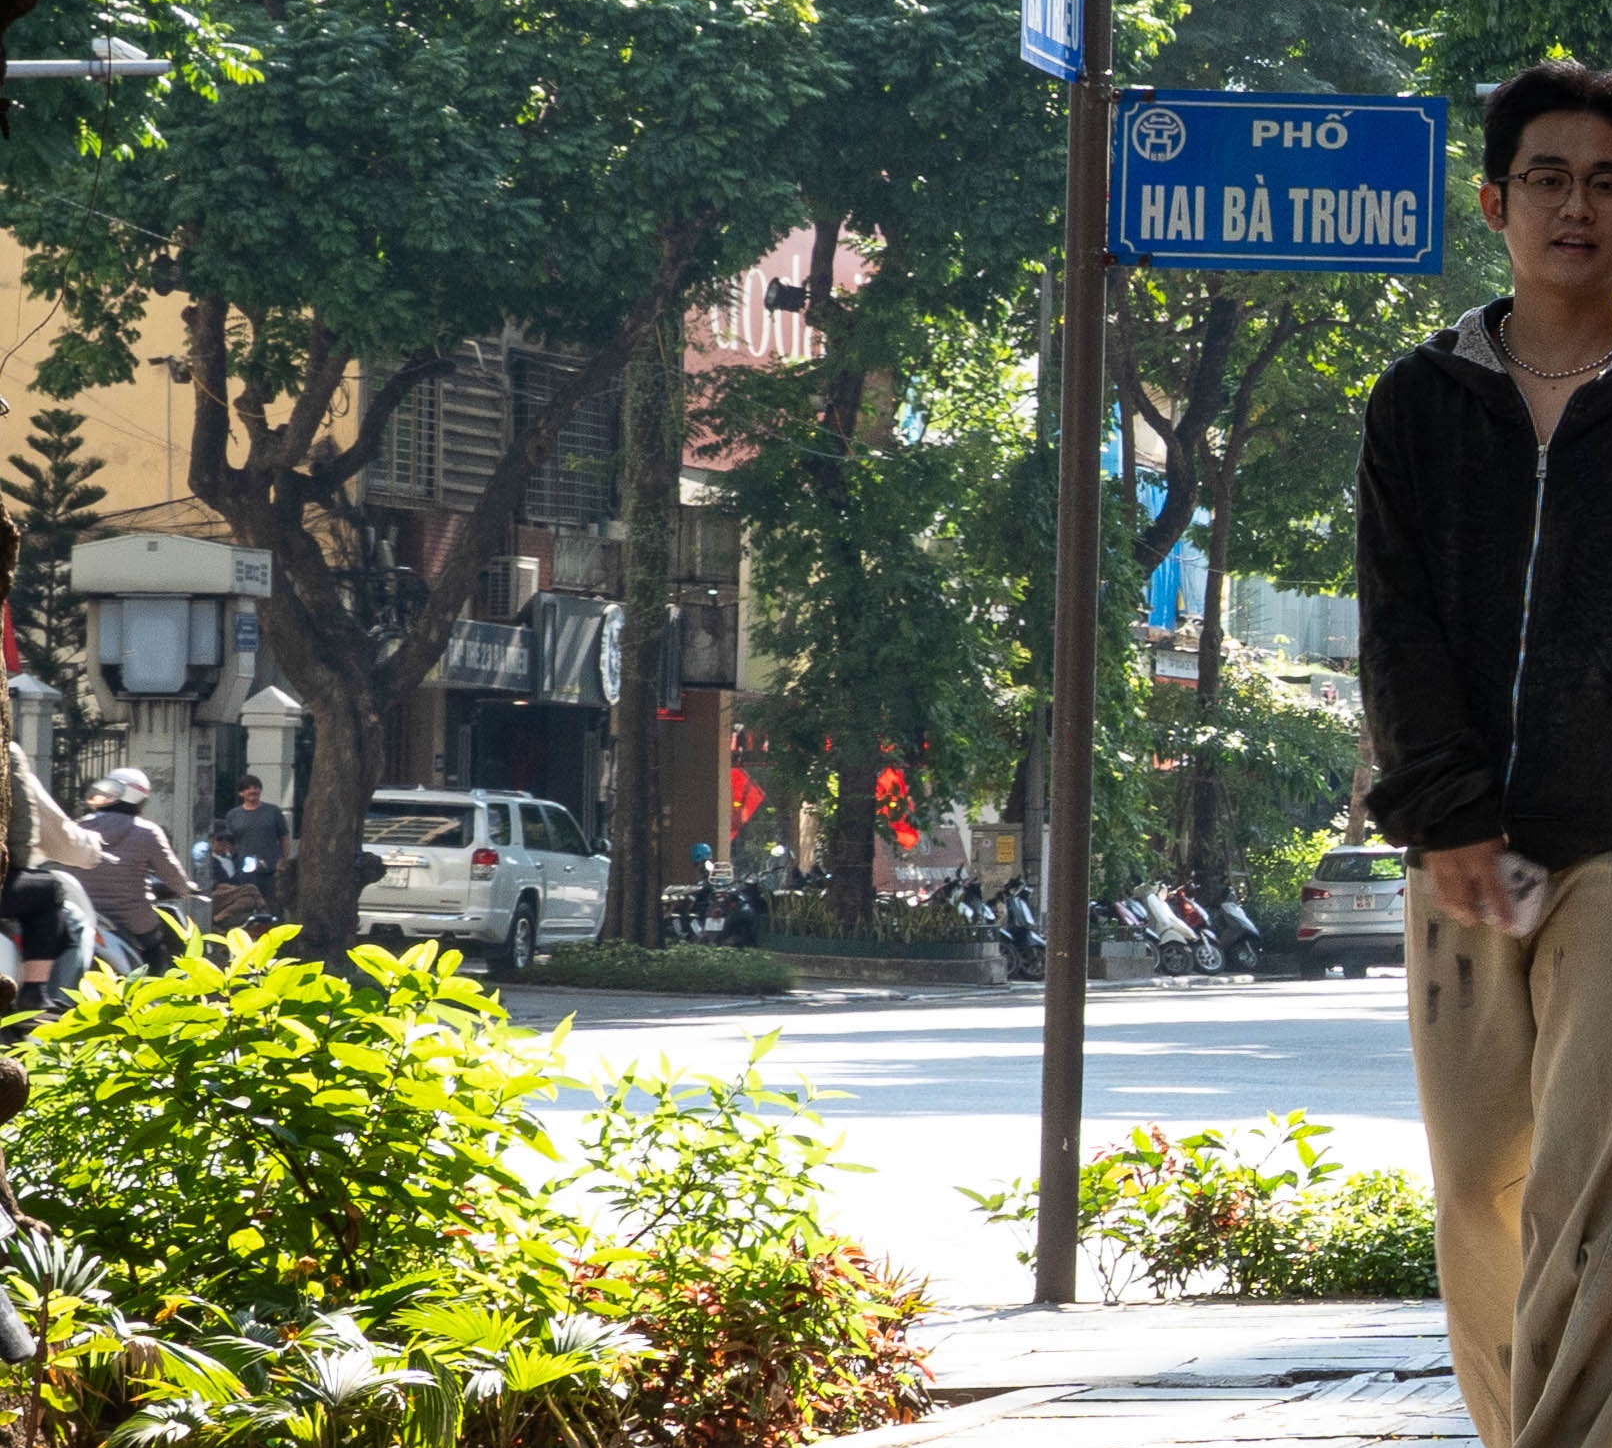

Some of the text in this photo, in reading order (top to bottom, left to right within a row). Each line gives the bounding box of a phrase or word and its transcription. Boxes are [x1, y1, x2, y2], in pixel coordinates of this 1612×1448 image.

[1252, 109, 1353, 149] PHỐ
[1140, 174, 1417, 246] HAI BÀ TRƯNG
